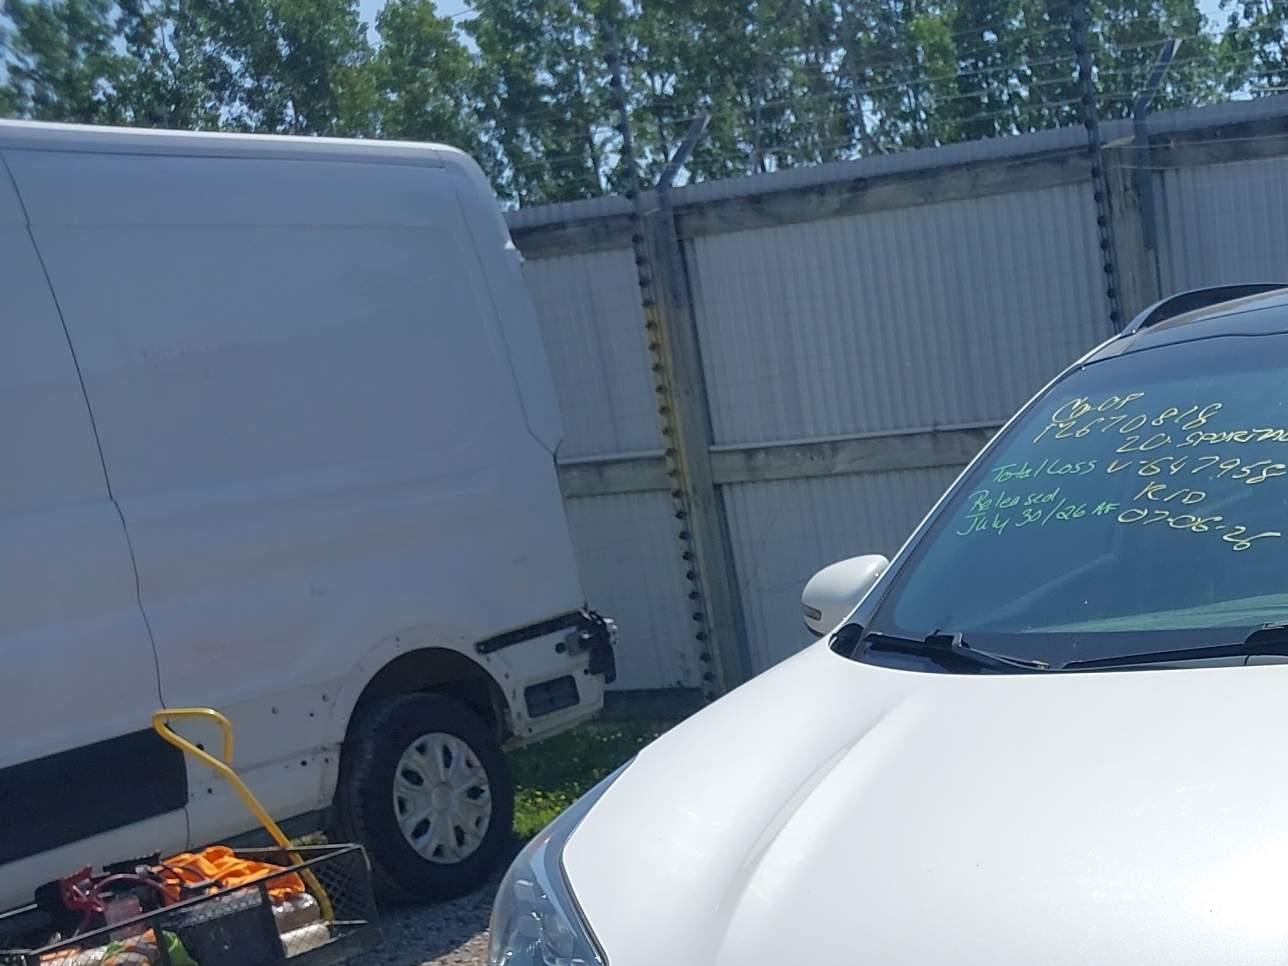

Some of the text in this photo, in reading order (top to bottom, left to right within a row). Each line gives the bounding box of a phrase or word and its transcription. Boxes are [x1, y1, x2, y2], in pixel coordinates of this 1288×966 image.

[1033, 402, 1223, 444] 12670818
[992, 459, 1048, 483] Total
[968, 487, 1061, 512] Released
[957, 512, 1010, 536] July
[1015, 498, 1088, 527] 30/26
